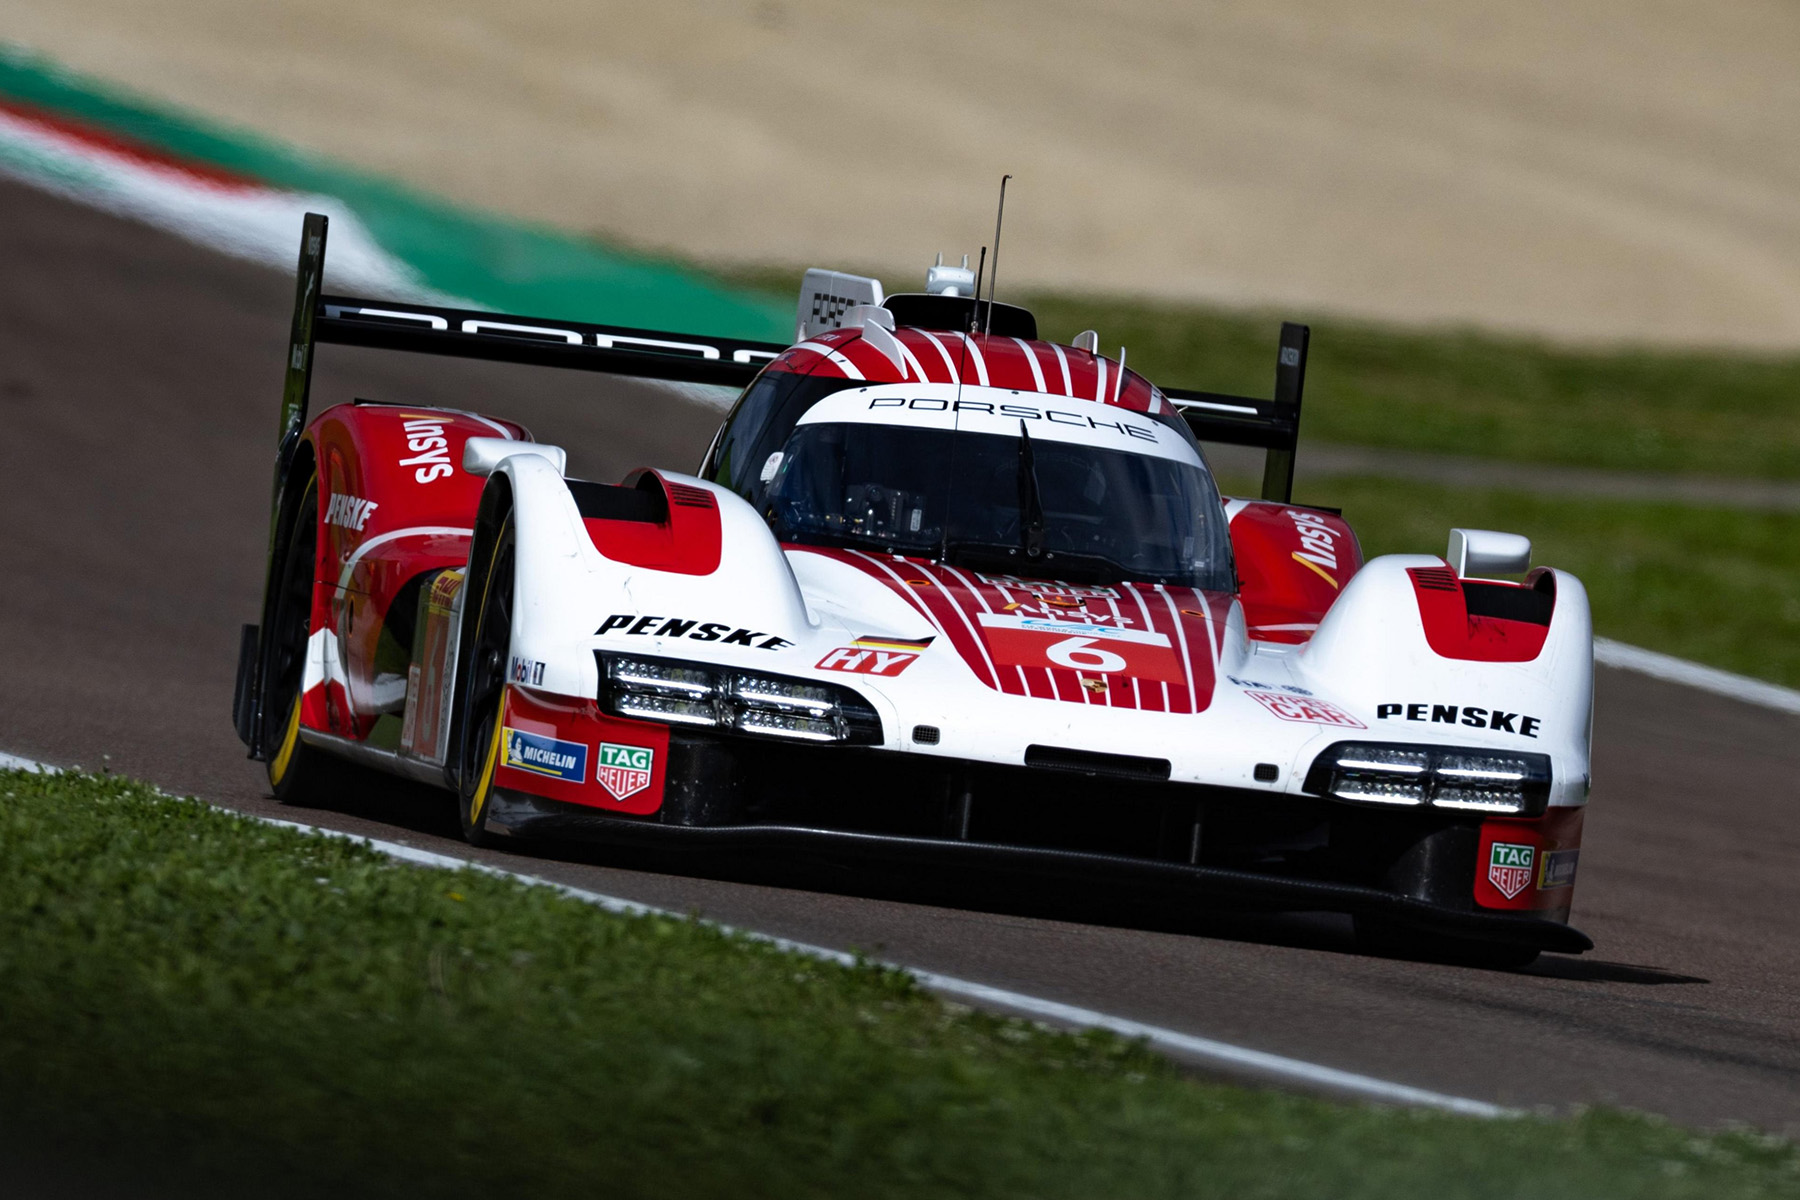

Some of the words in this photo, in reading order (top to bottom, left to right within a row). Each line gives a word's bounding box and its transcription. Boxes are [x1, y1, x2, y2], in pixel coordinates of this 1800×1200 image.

[869, 398, 1159, 443] PORSCHE
[399, 413, 454, 484] Ansys
[324, 492, 379, 532] PENSKE
[1287, 510, 1341, 590] Ansys
[1003, 602, 1134, 624] Ansys
[594, 614, 795, 652] PENSKE
[828, 649, 908, 672] HY
[1046, 636, 1127, 673] 6
[511, 656, 533, 682] Mobil
[533, 661, 546, 686] 1
[1270, 702, 1357, 725] CAR
[1377, 703, 1541, 738] PENSKE
[524, 746, 577, 769] MICHELIN
[604, 748, 647, 768] TAG
[600, 768, 648, 796] HEUER
[1496, 847, 1531, 865] TAG
[1492, 867, 1530, 894] HEUER
